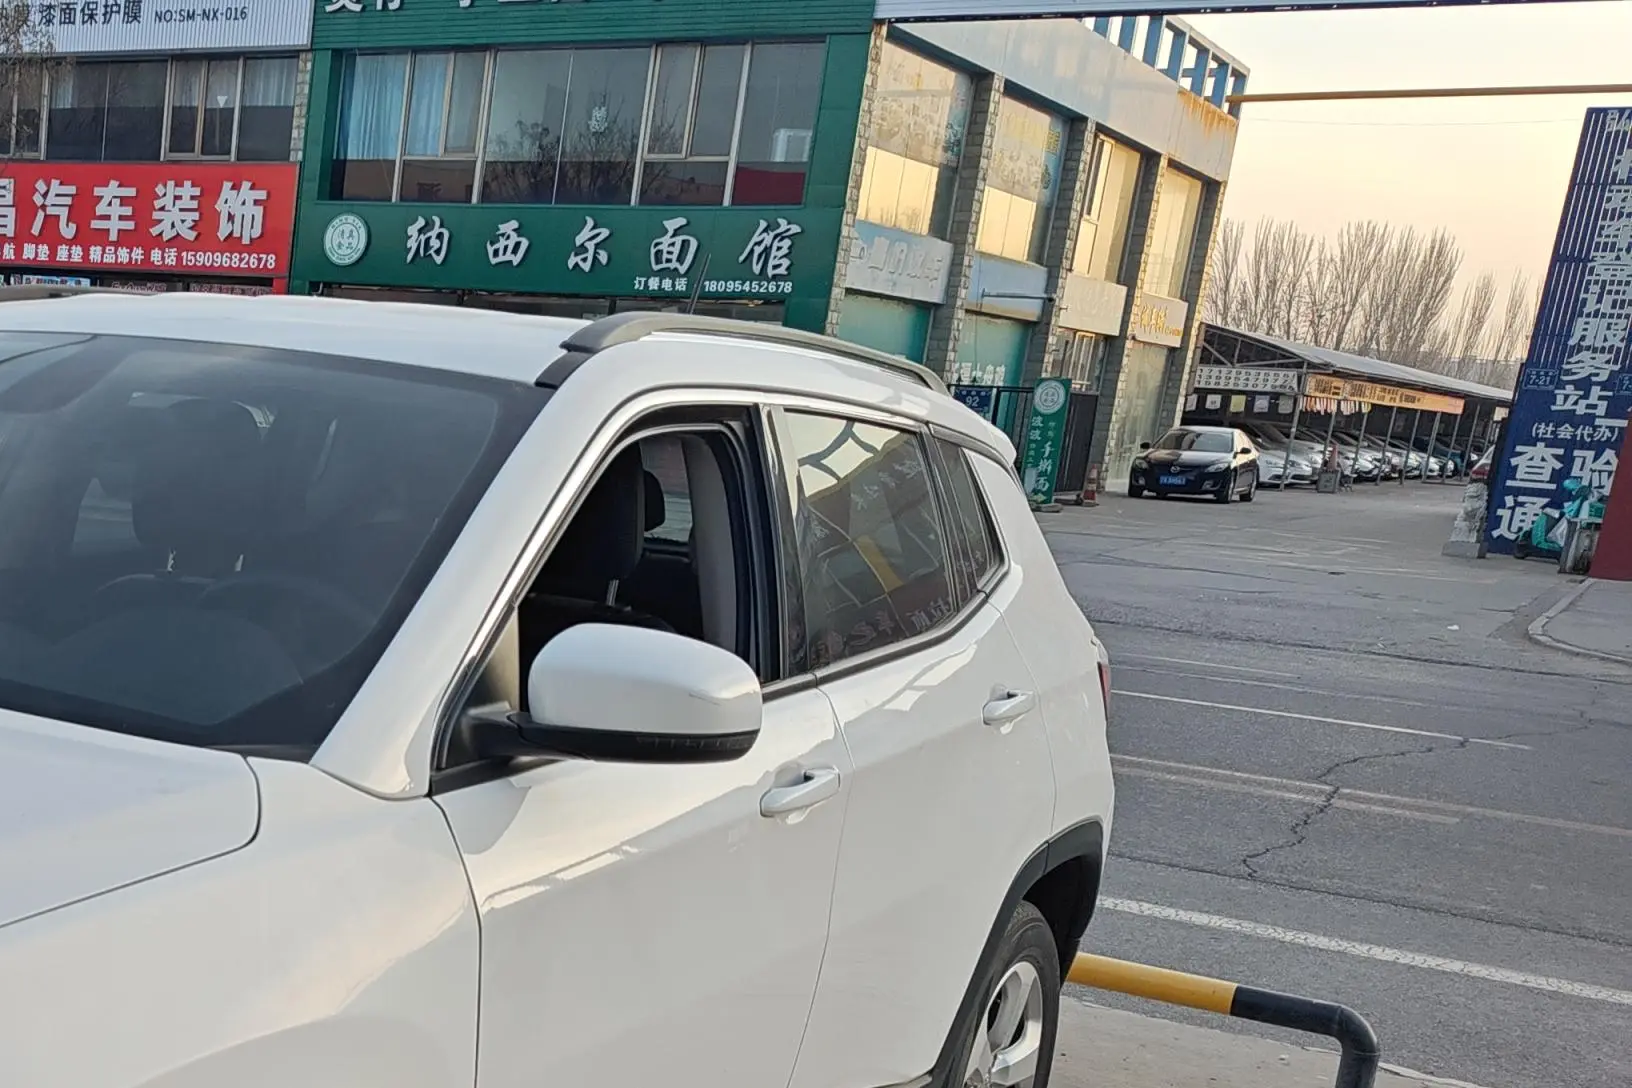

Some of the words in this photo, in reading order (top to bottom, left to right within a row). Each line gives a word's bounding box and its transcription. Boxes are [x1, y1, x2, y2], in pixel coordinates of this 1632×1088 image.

[38, 1, 142, 27] 漆面保护膜
[23, 242, 50, 261] 脚垫
[56, 244, 84, 263] 座垫
[88, 245, 145, 265] 精品饰件
[150, 247, 177, 267] 电话
[181, 250, 277, 269] 15909682678
[405, 215, 803, 277] 纳西尔面馆
[703, 280, 793, 294] 18095452678
[966, 395, 980, 407] 92
